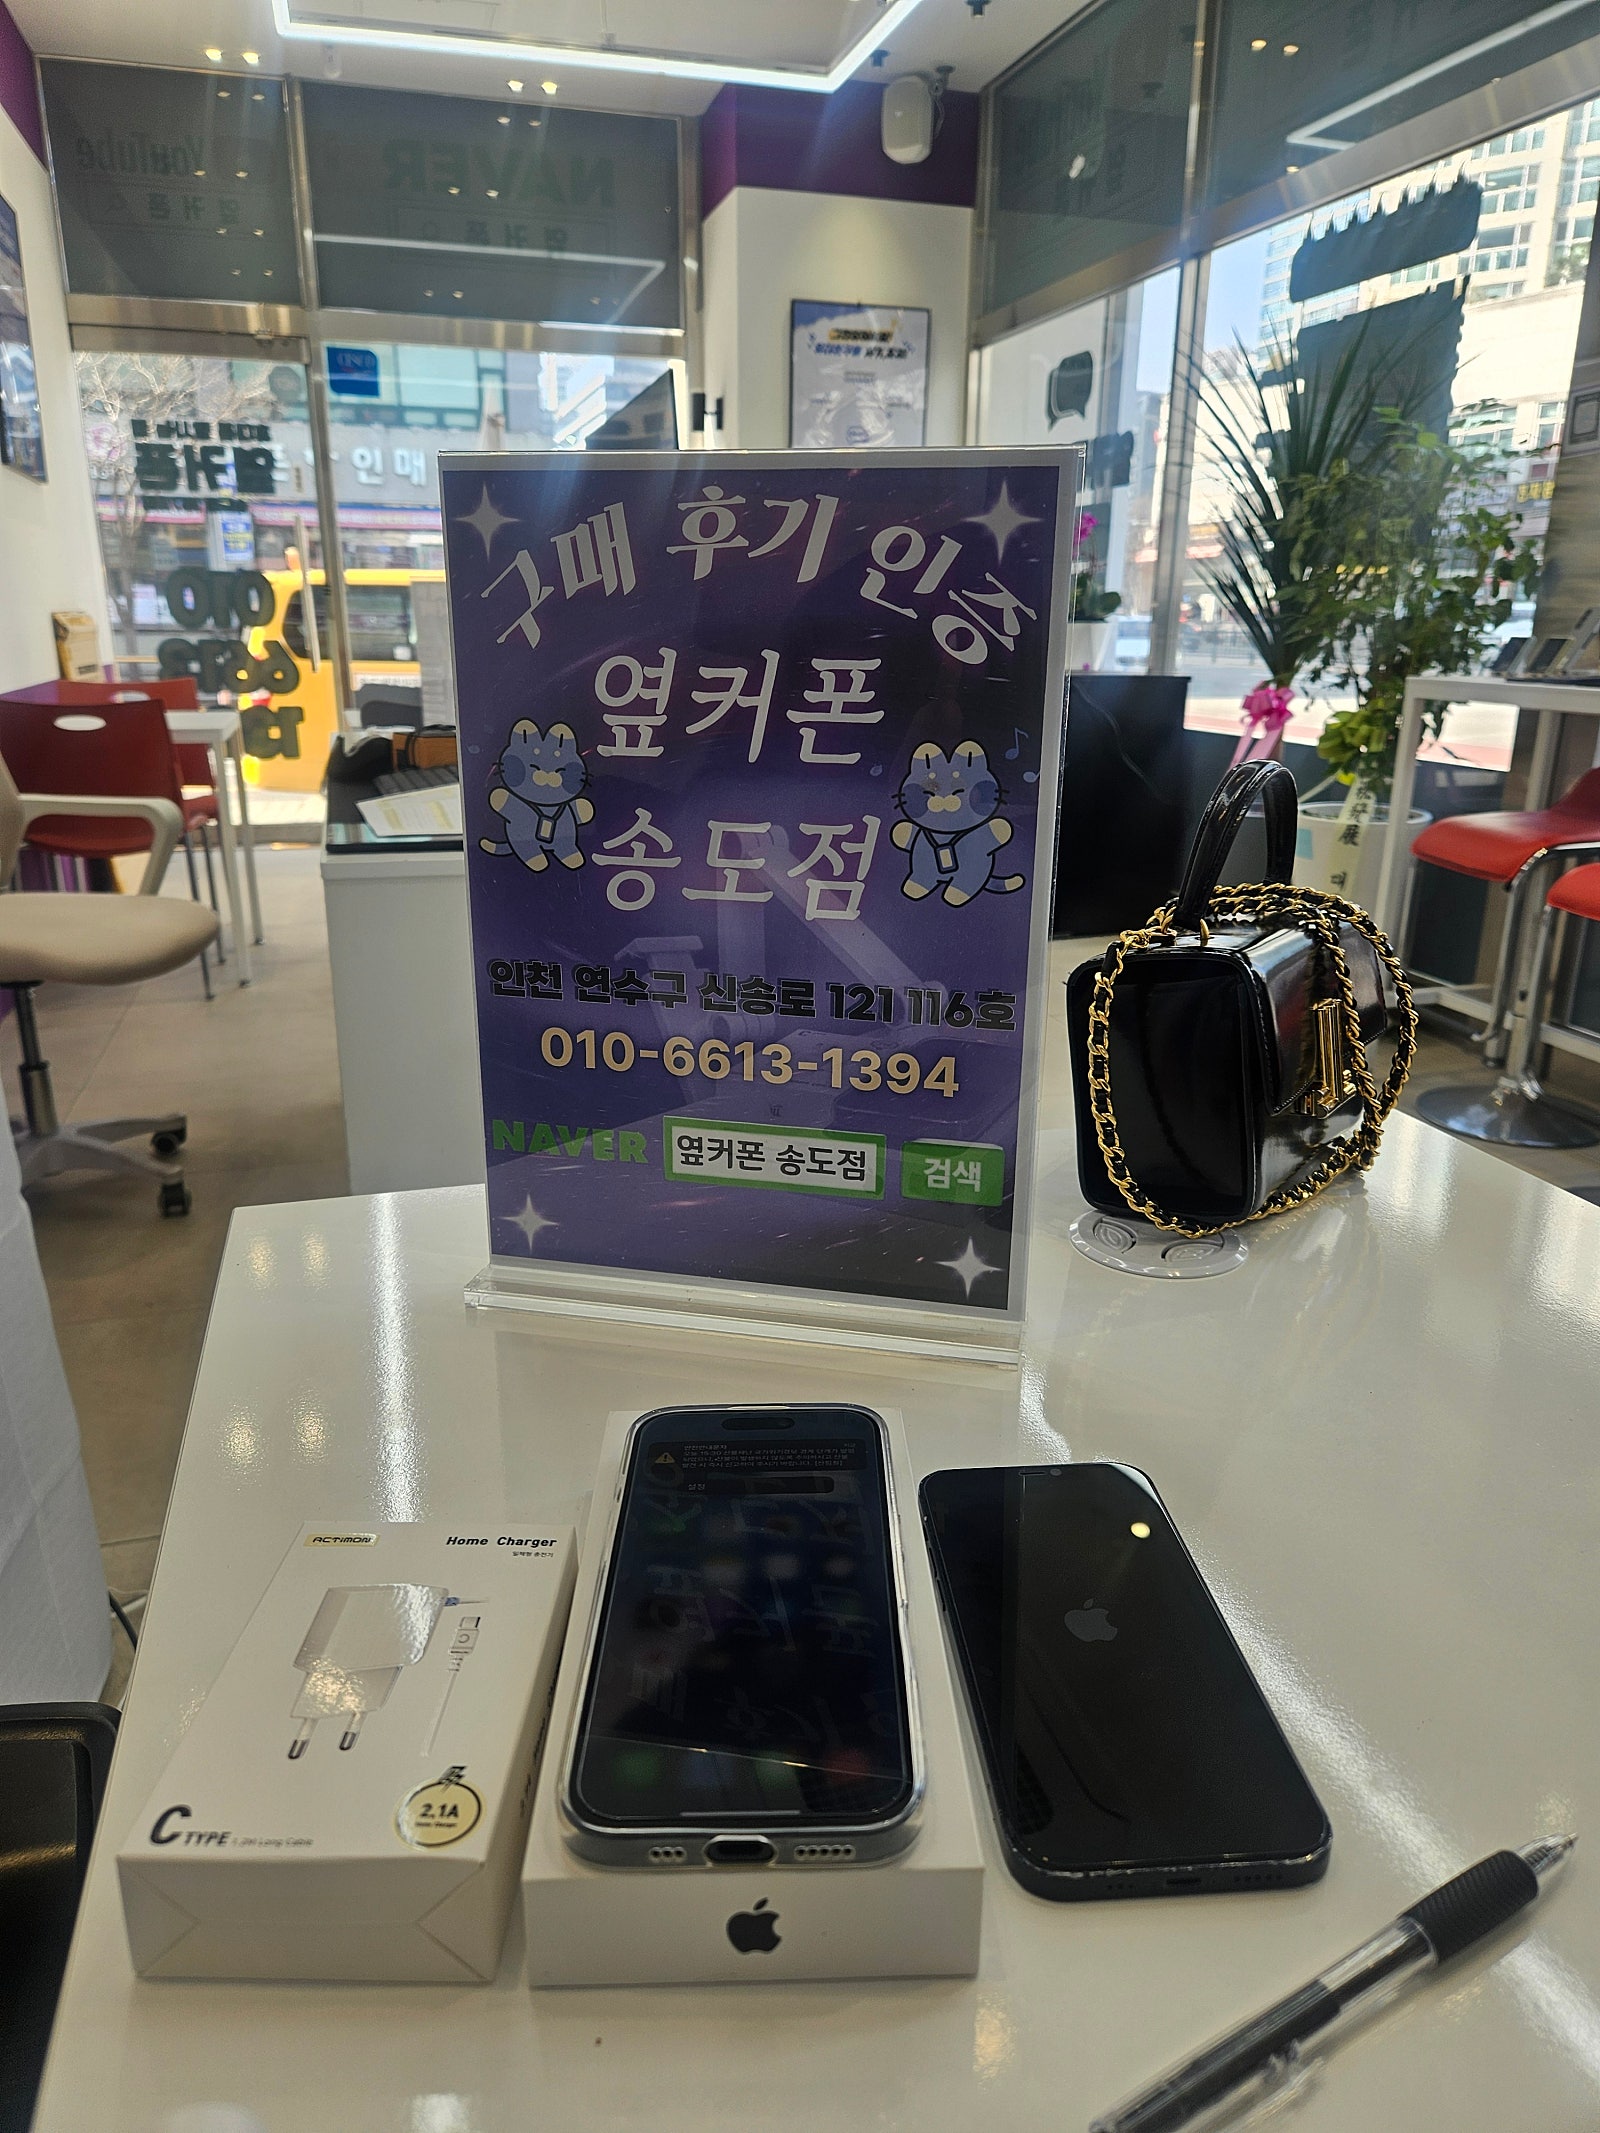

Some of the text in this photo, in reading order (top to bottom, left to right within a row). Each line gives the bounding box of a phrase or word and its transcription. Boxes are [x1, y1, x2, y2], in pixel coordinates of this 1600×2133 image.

[481, 485, 1038, 664] 구매 후기 인증
[594, 647, 885, 764] 옆커폰
[591, 808, 881, 921] 송도점
[487, 959, 1017, 1032] 인천 연수구 신송로 121 116호
[540, 1026, 960, 1098] 010-6613-1394
[491, 1118, 649, 1164] NAVER
[676, 1134, 868, 1182] 옆커폰 송도점
[923, 1157, 983, 1193] 검색
[446, 1536, 557, 1548] Home Charger
[420, 1803, 459, 1818] 2.1A
